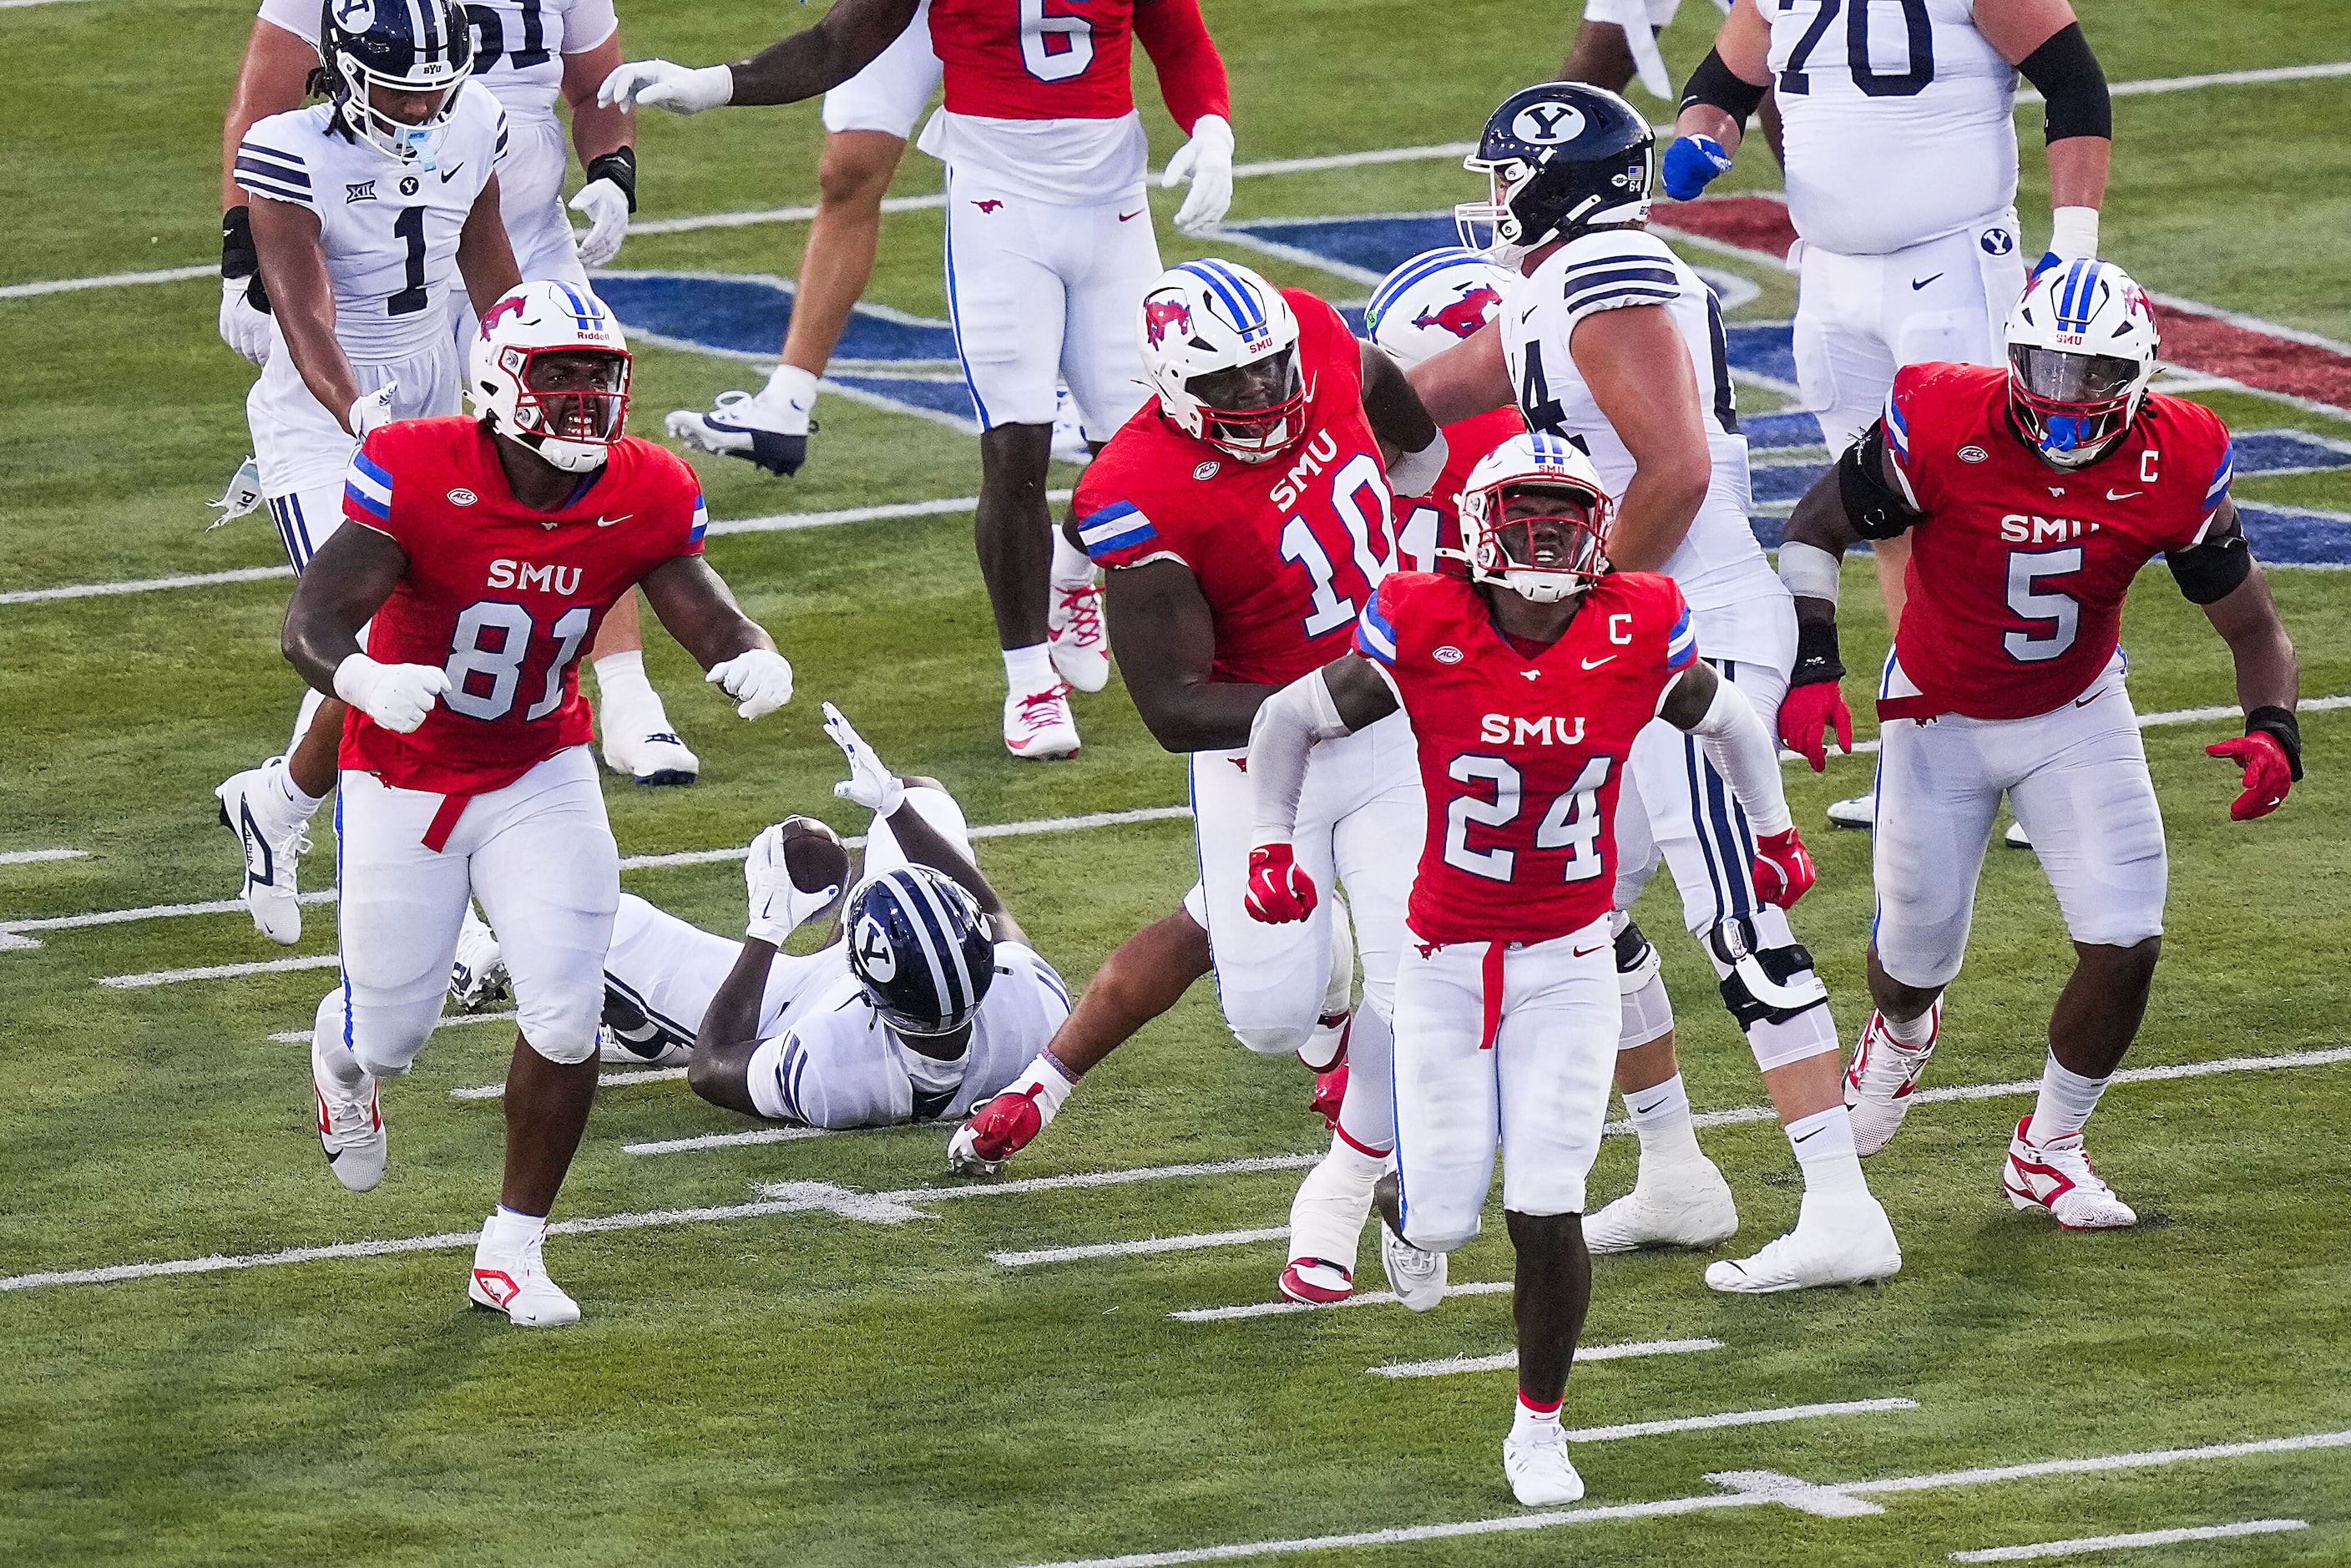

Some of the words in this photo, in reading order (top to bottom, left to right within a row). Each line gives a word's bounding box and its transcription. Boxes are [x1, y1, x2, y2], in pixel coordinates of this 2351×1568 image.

[1018, 0, 1095, 83] 6
[1779, 0, 1935, 97] 70
[423, 64, 442, 75] BYU
[1523, 106, 1574, 139] Y
[346, 180, 377, 205] XII
[402, 178, 417, 195] Y
[1628, 180, 1641, 192] 64
[1983, 230, 2008, 254] Y
[387, 205, 428, 316] 1
[1249, 337, 1273, 354] SMU
[2056, 333, 2083, 346] SMU
[1512, 339, 1591, 457] 4
[1269, 427, 1338, 513] SMU
[2140, 450, 2160, 483] C
[1279, 452, 1399, 640] 10
[487, 559, 583, 595] SMU
[2003, 545, 2083, 663] 5
[1608, 613, 1632, 645] C
[440, 599, 593, 722] 81
[1480, 713, 1585, 746] SMU
[1443, 753, 1613, 883] 24
[858, 921, 891, 968] Y
